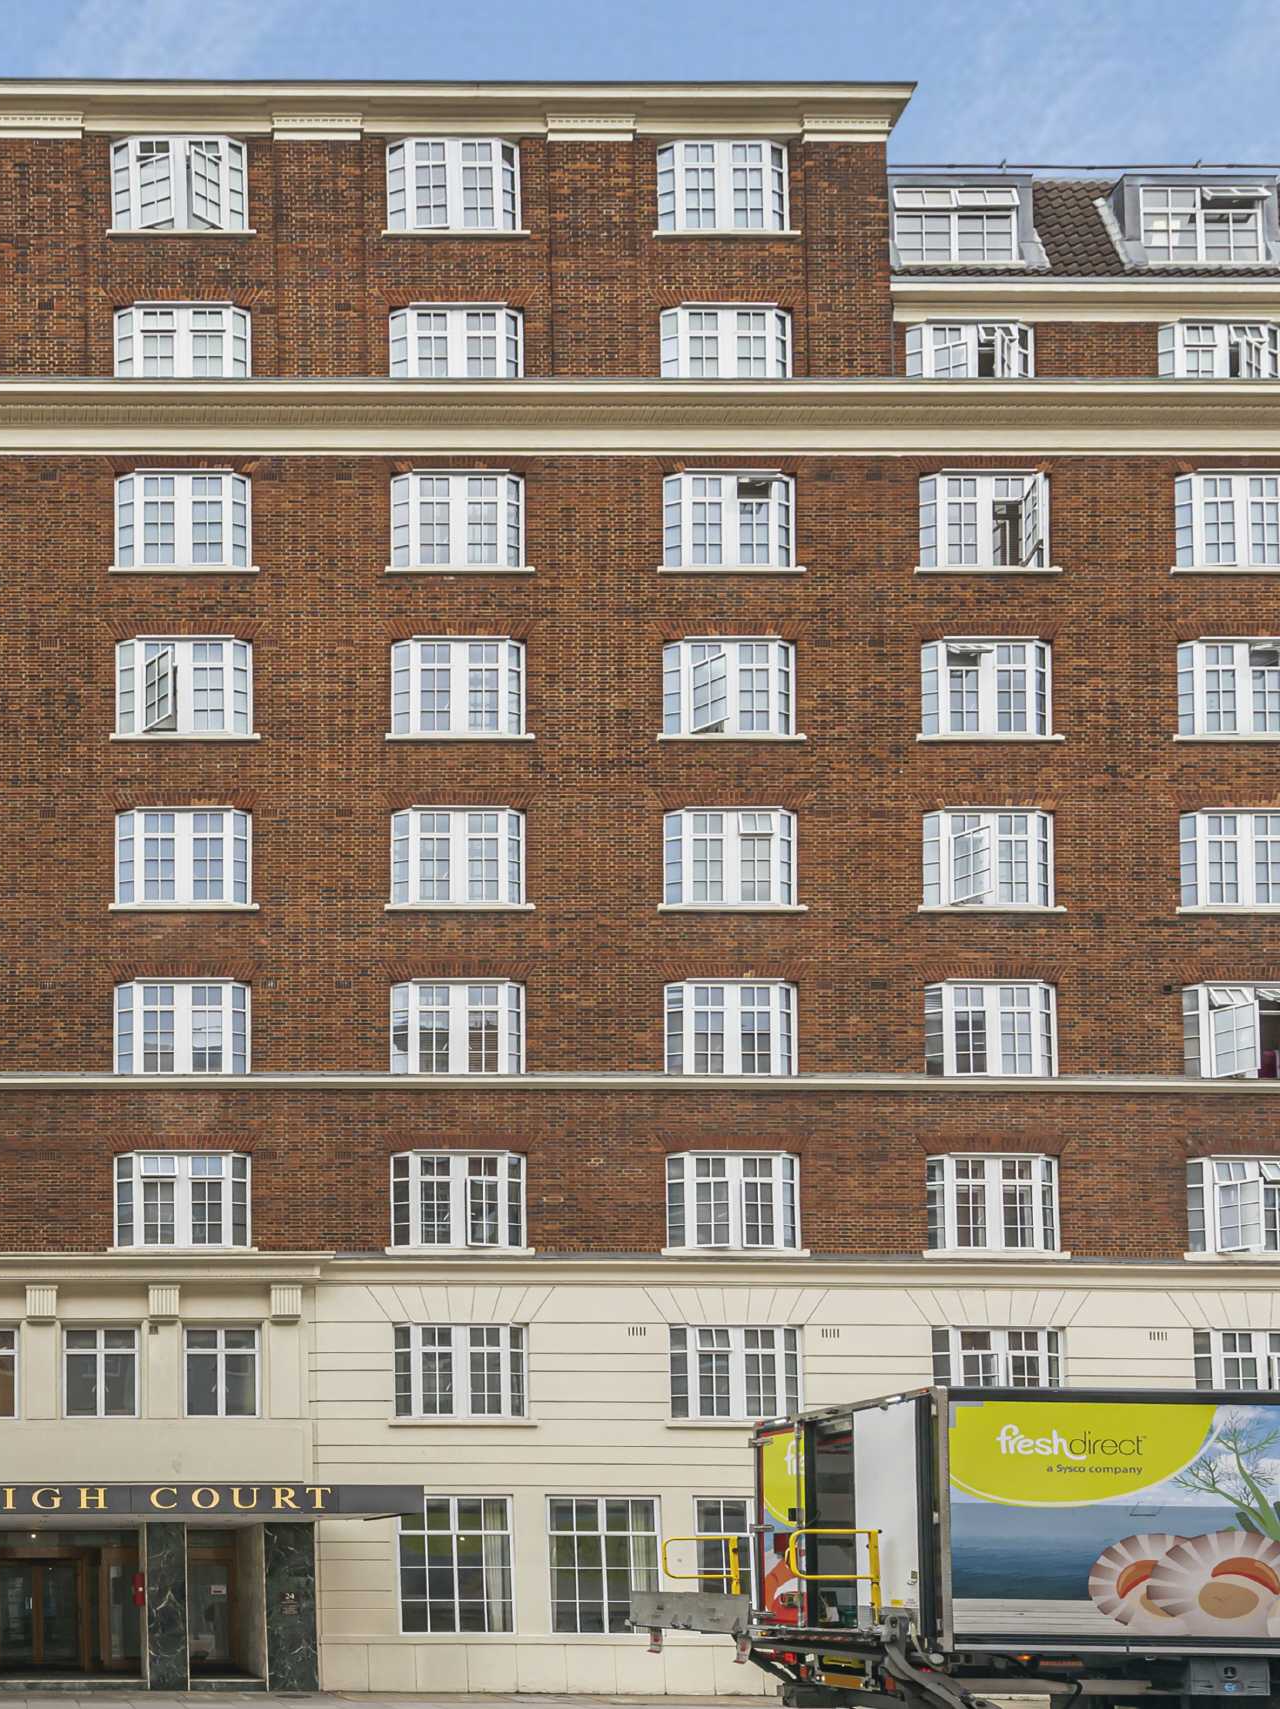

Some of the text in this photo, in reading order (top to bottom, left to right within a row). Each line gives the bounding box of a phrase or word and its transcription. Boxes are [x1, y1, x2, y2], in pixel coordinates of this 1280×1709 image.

[1046, 1464, 1143, 1475] a Sysco company
[149, 1487, 332, 1509] COURT
